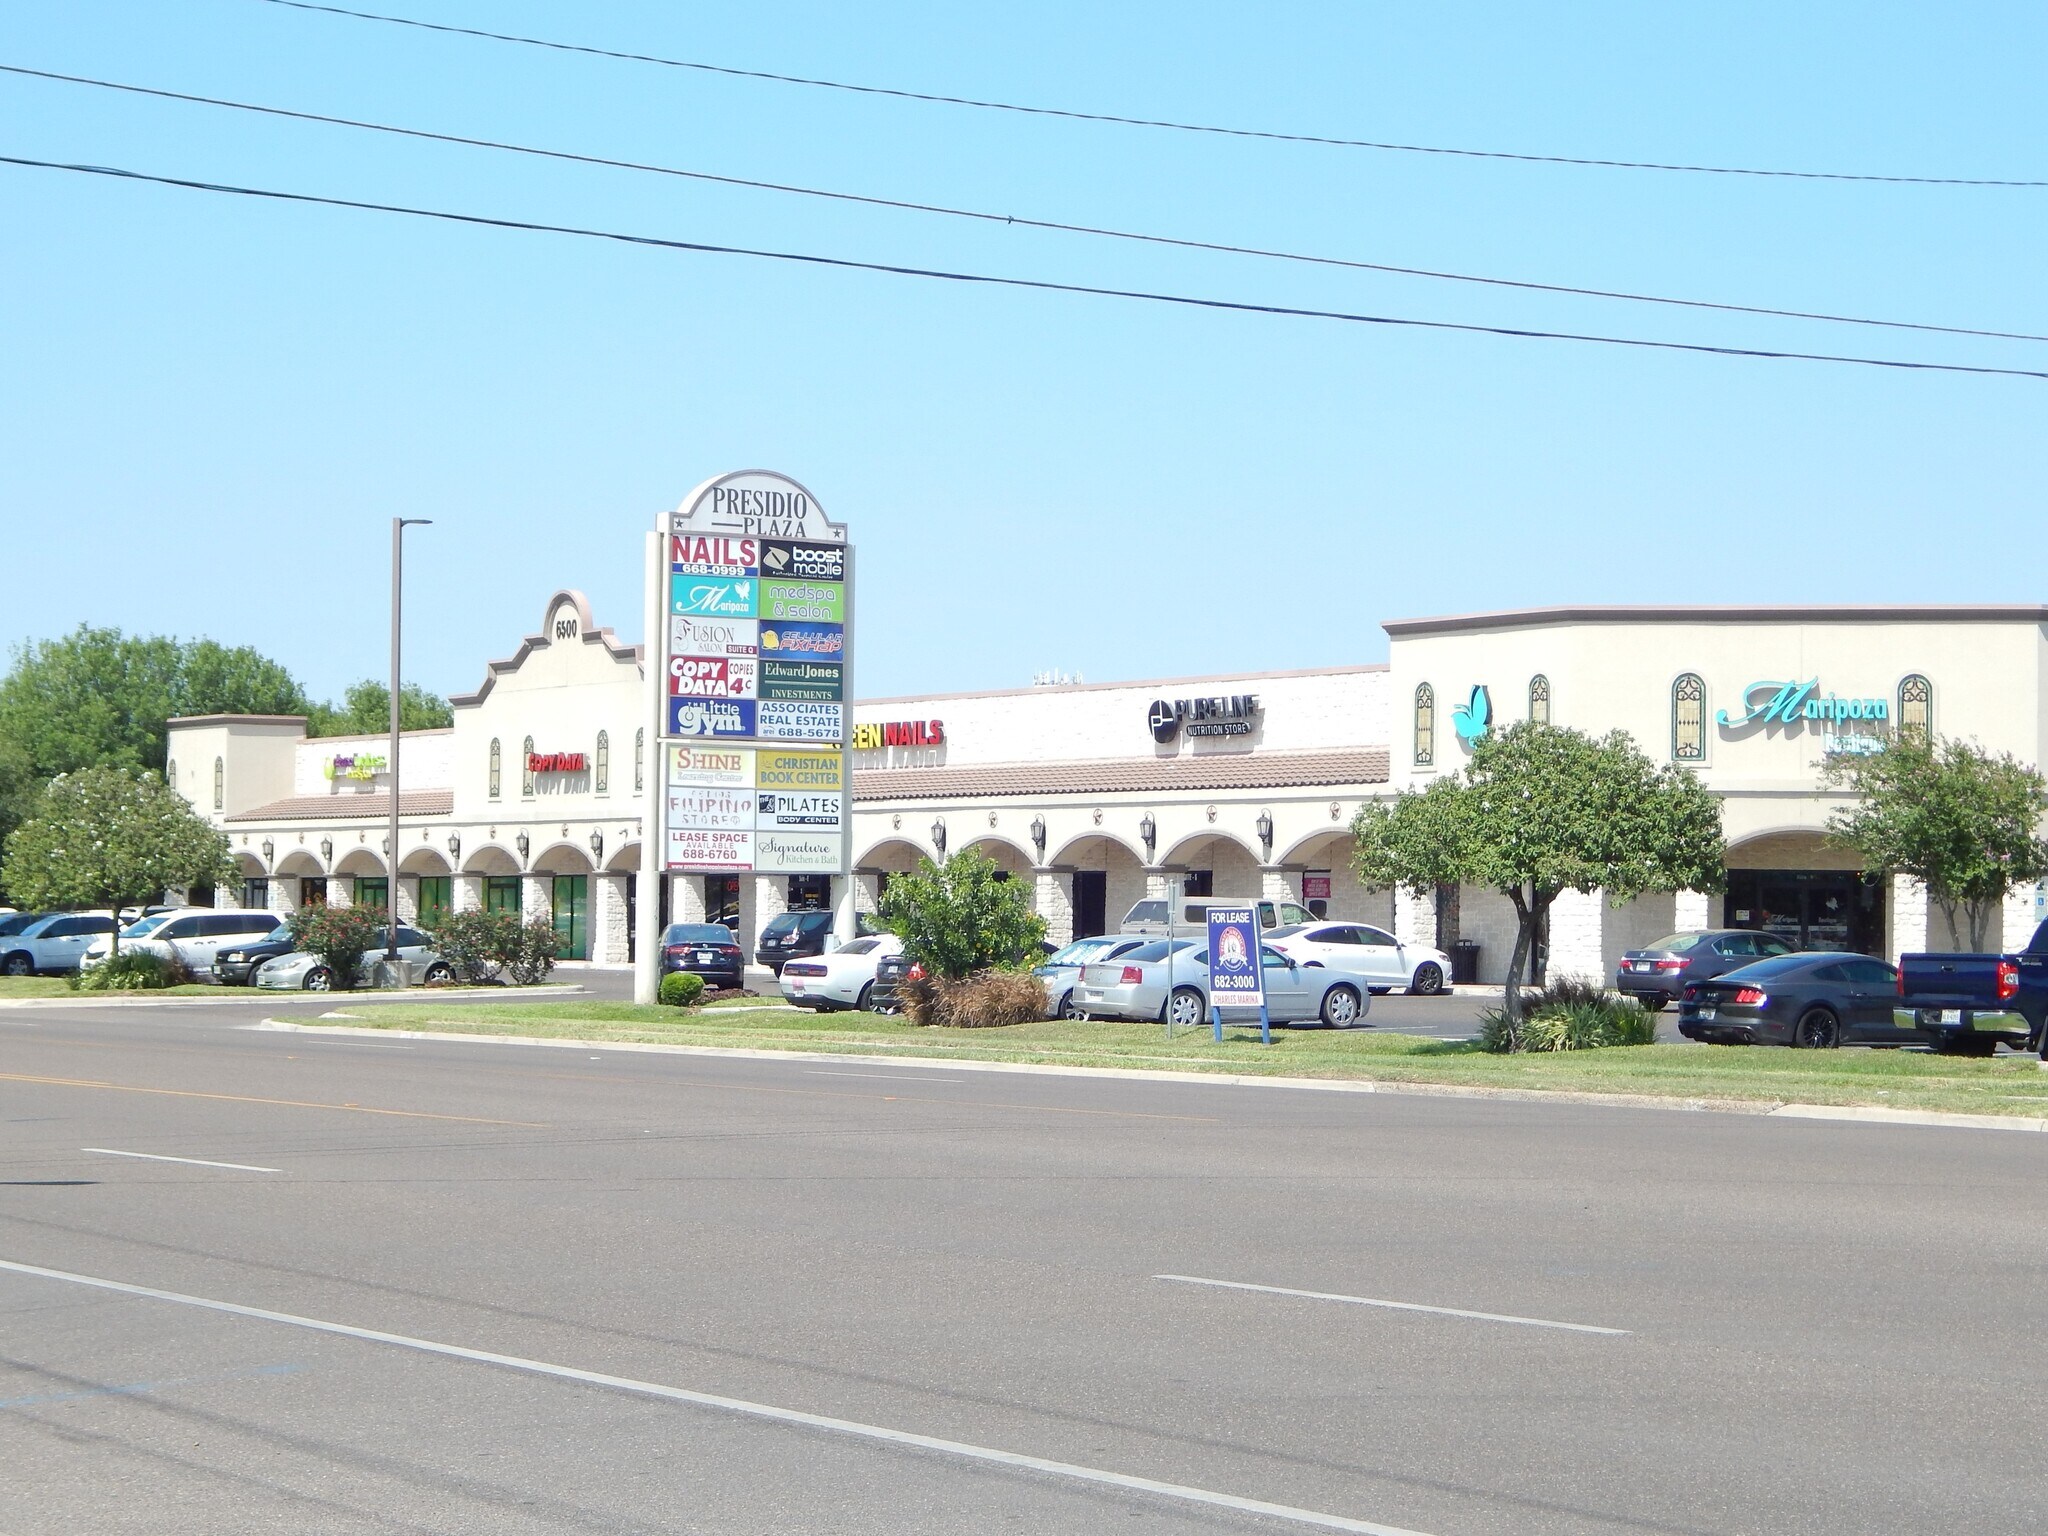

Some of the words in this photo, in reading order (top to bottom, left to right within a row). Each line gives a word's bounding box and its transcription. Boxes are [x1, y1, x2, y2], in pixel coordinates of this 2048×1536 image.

[713, 487, 807, 519] PRESIDIO
[743, 517, 807, 537] PLAZA
[672, 535, 756, 566] NAILS
[793, 546, 843, 563] boost
[682, 564, 745, 576] 668-0999
[793, 562, 842, 575] mobile
[675, 584, 749, 615] Maripoza
[769, 583, 836, 604] medspa
[773, 601, 785, 617] &
[788, 602, 832, 619] salon
[556, 619, 577, 639] 6500
[674, 619, 735, 645] FUSION
[781, 631, 843, 642] CELLULAR
[698, 643, 722, 653] SALON
[671, 658, 722, 678] COPY
[729, 663, 753, 675] COPIES
[765, 662, 804, 677] Edward
[805, 664, 839, 678] Jones
[678, 676, 727, 695] DATA
[771, 689, 832, 699] INVESTMENTS
[1716, 676, 1887, 726] Maripoza
[703, 700, 740, 714] Little
[762, 703, 839, 714] ASSOCIATES
[678, 705, 741, 735] gym
[760, 715, 791, 725] REAL
[796, 716, 839, 726] ESTATE
[779, 728, 839, 737] 688-5678
[885, 720, 944, 747] NAILS
[1187, 725, 1223, 736] NUTRITION
[1225, 723, 1247, 734] STORE
[529, 752, 557, 772] COPY
[557, 752, 583, 772] DATA
[677, 747, 741, 770] SHINE
[775, 758, 838, 769] CHRISTIAN
[761, 772, 794, 783] BOOK
[796, 772, 839, 784] CENTER
[670, 797, 752, 813] FILIPINO
[778, 798, 839, 813] PILATES
[682, 814, 729, 825] STORE
[673, 833, 708, 841] LEASE
[712, 834, 748, 842] SPACE
[683, 849, 737, 859] 688-6760
[759, 837, 830, 865] Signature
[786, 855, 813, 863] Kitchen
[821, 856, 838, 864] Bath
[1211, 913, 1226, 923] FOR
[1226, 912, 1250, 923] LEASE
[1214, 975, 1254, 988] 682-3000
